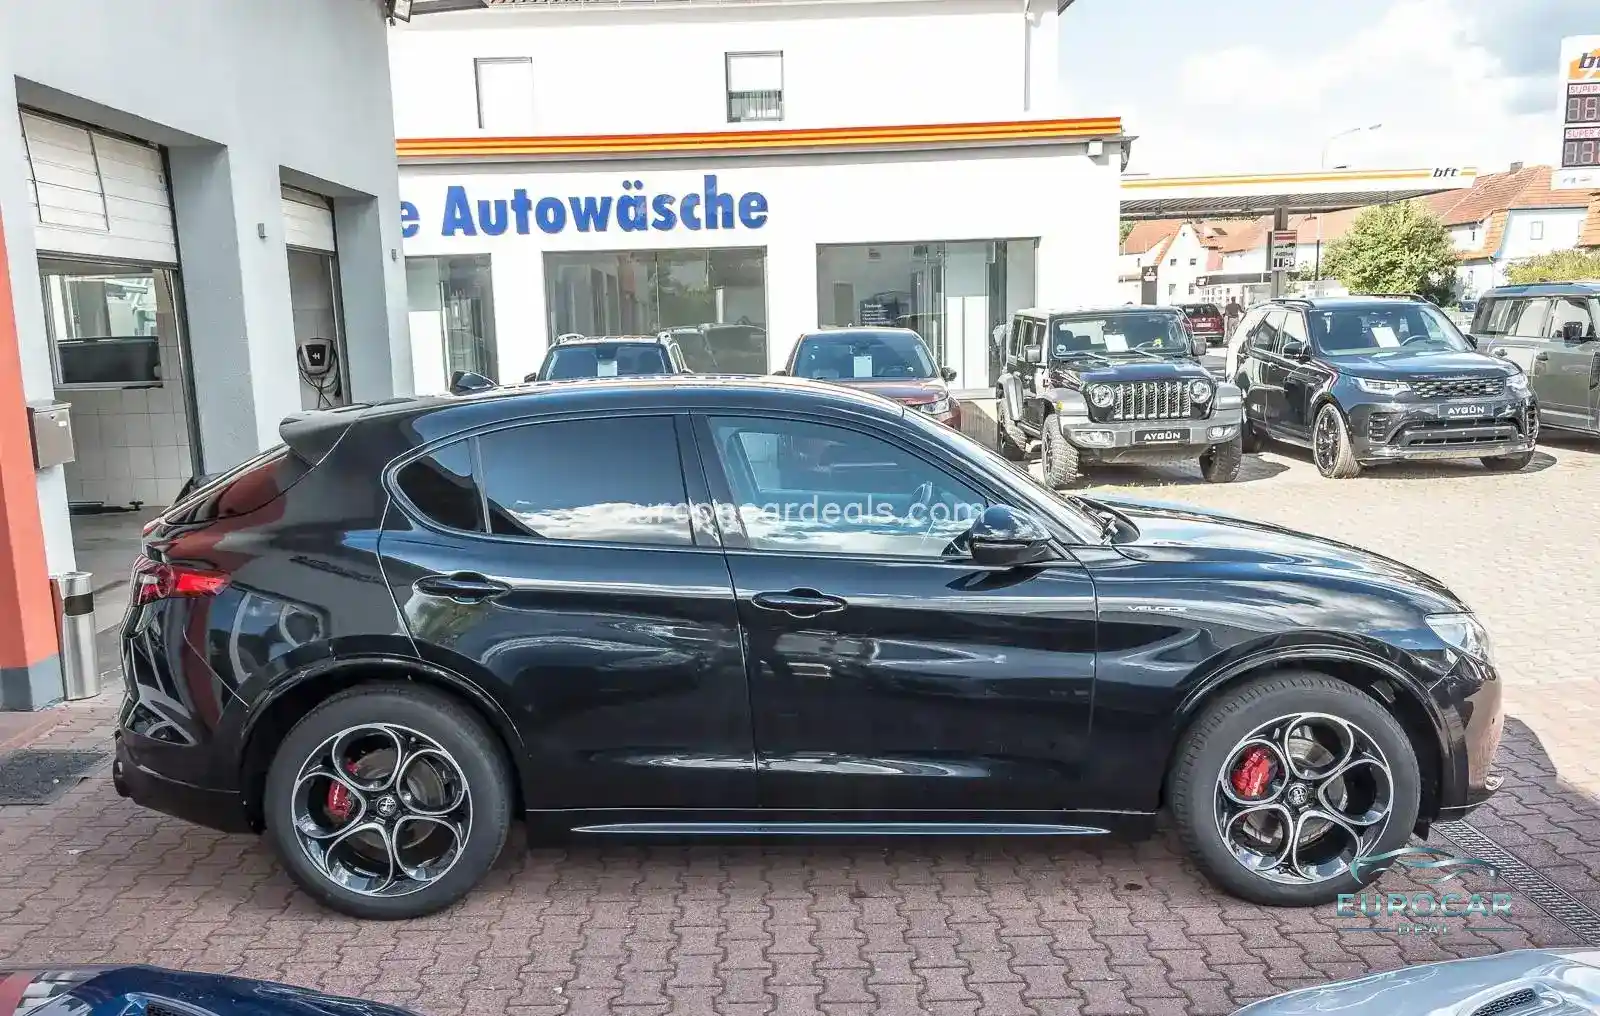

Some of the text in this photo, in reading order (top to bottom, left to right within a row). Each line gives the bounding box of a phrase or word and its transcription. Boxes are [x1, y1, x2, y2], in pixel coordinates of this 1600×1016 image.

[1566, 129, 1594, 138] SUPER
[1433, 167, 1458, 178] bft
[441, 174, 769, 236] Autowäsche
[1447, 404, 1485, 415] AYGÜN
